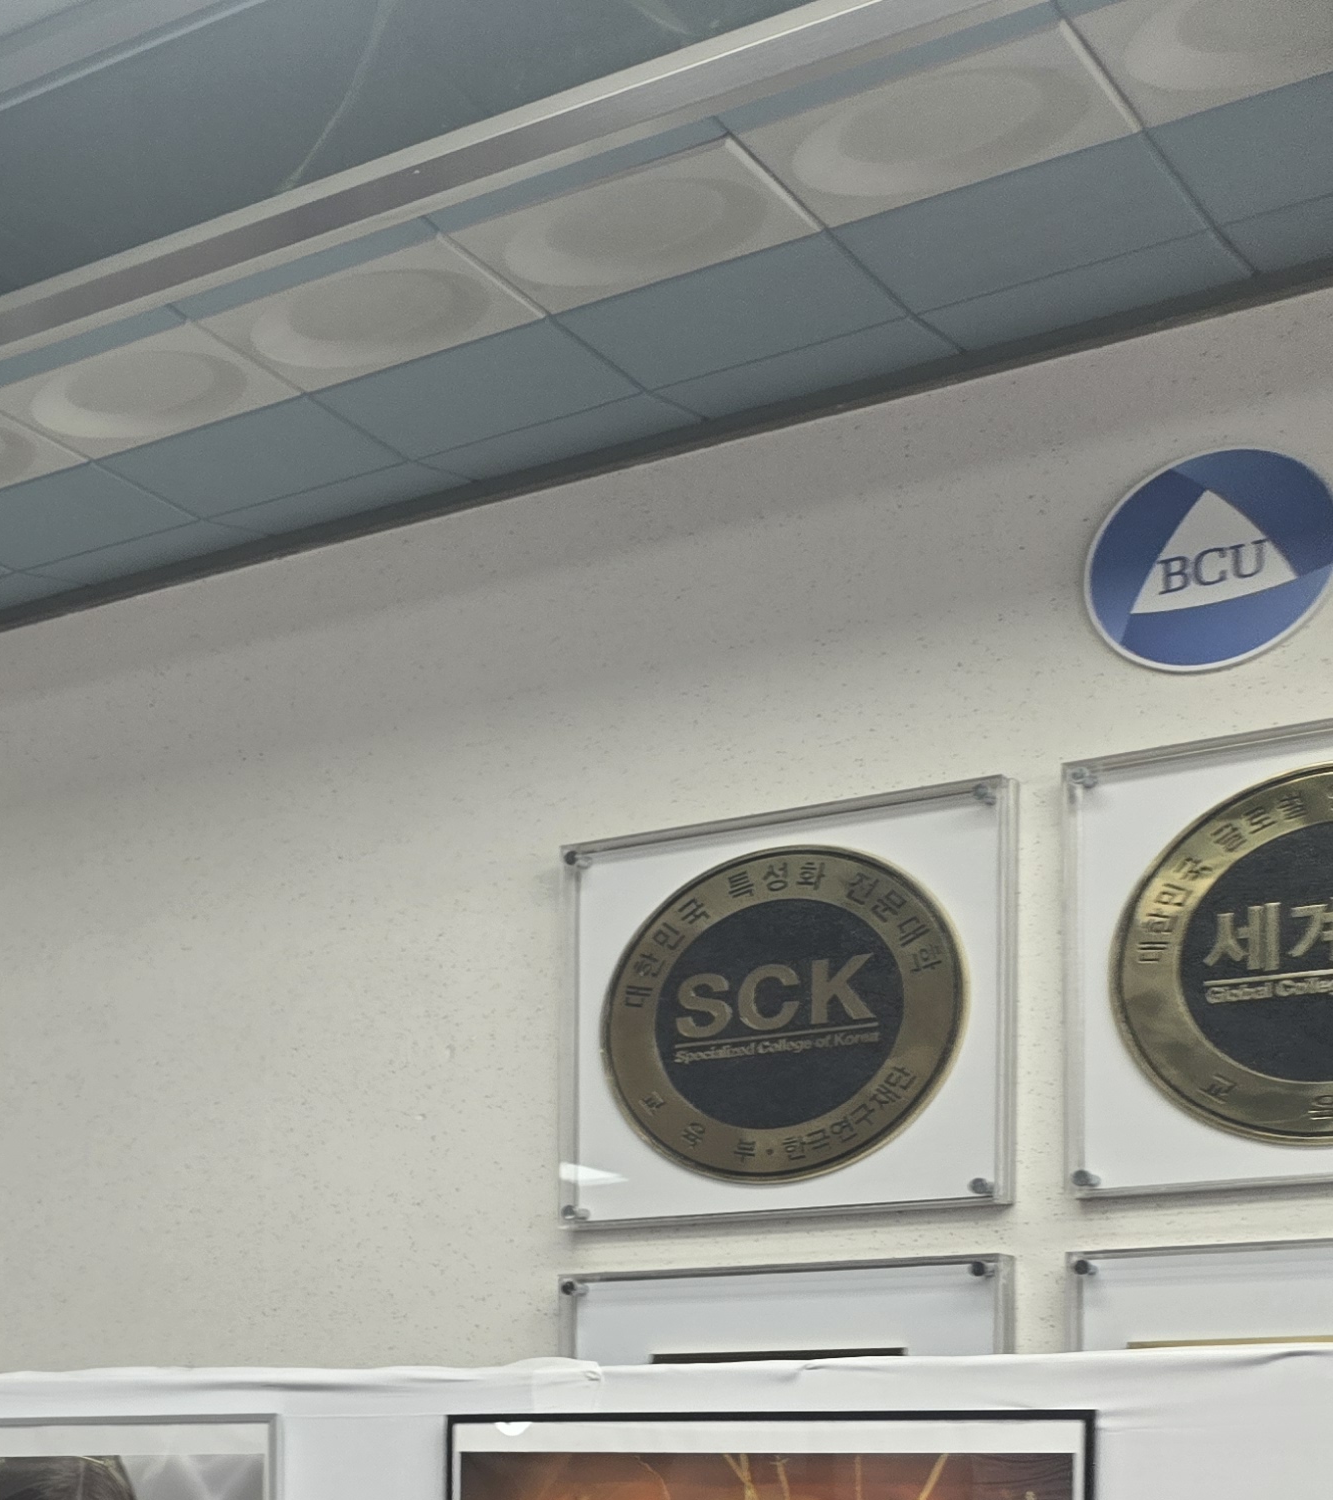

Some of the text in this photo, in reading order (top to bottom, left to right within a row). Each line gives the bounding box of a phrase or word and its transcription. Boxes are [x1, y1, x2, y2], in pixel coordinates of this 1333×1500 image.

[1156, 539, 1269, 595] BCU
[1137, 793, 1307, 964] 대한민국 글로벌
[624, 861, 942, 1008] 대한민국 특성화 전문대학
[675, 952, 877, 1039] SCK
[674, 1030, 881, 1064] Specialized College of Korea
